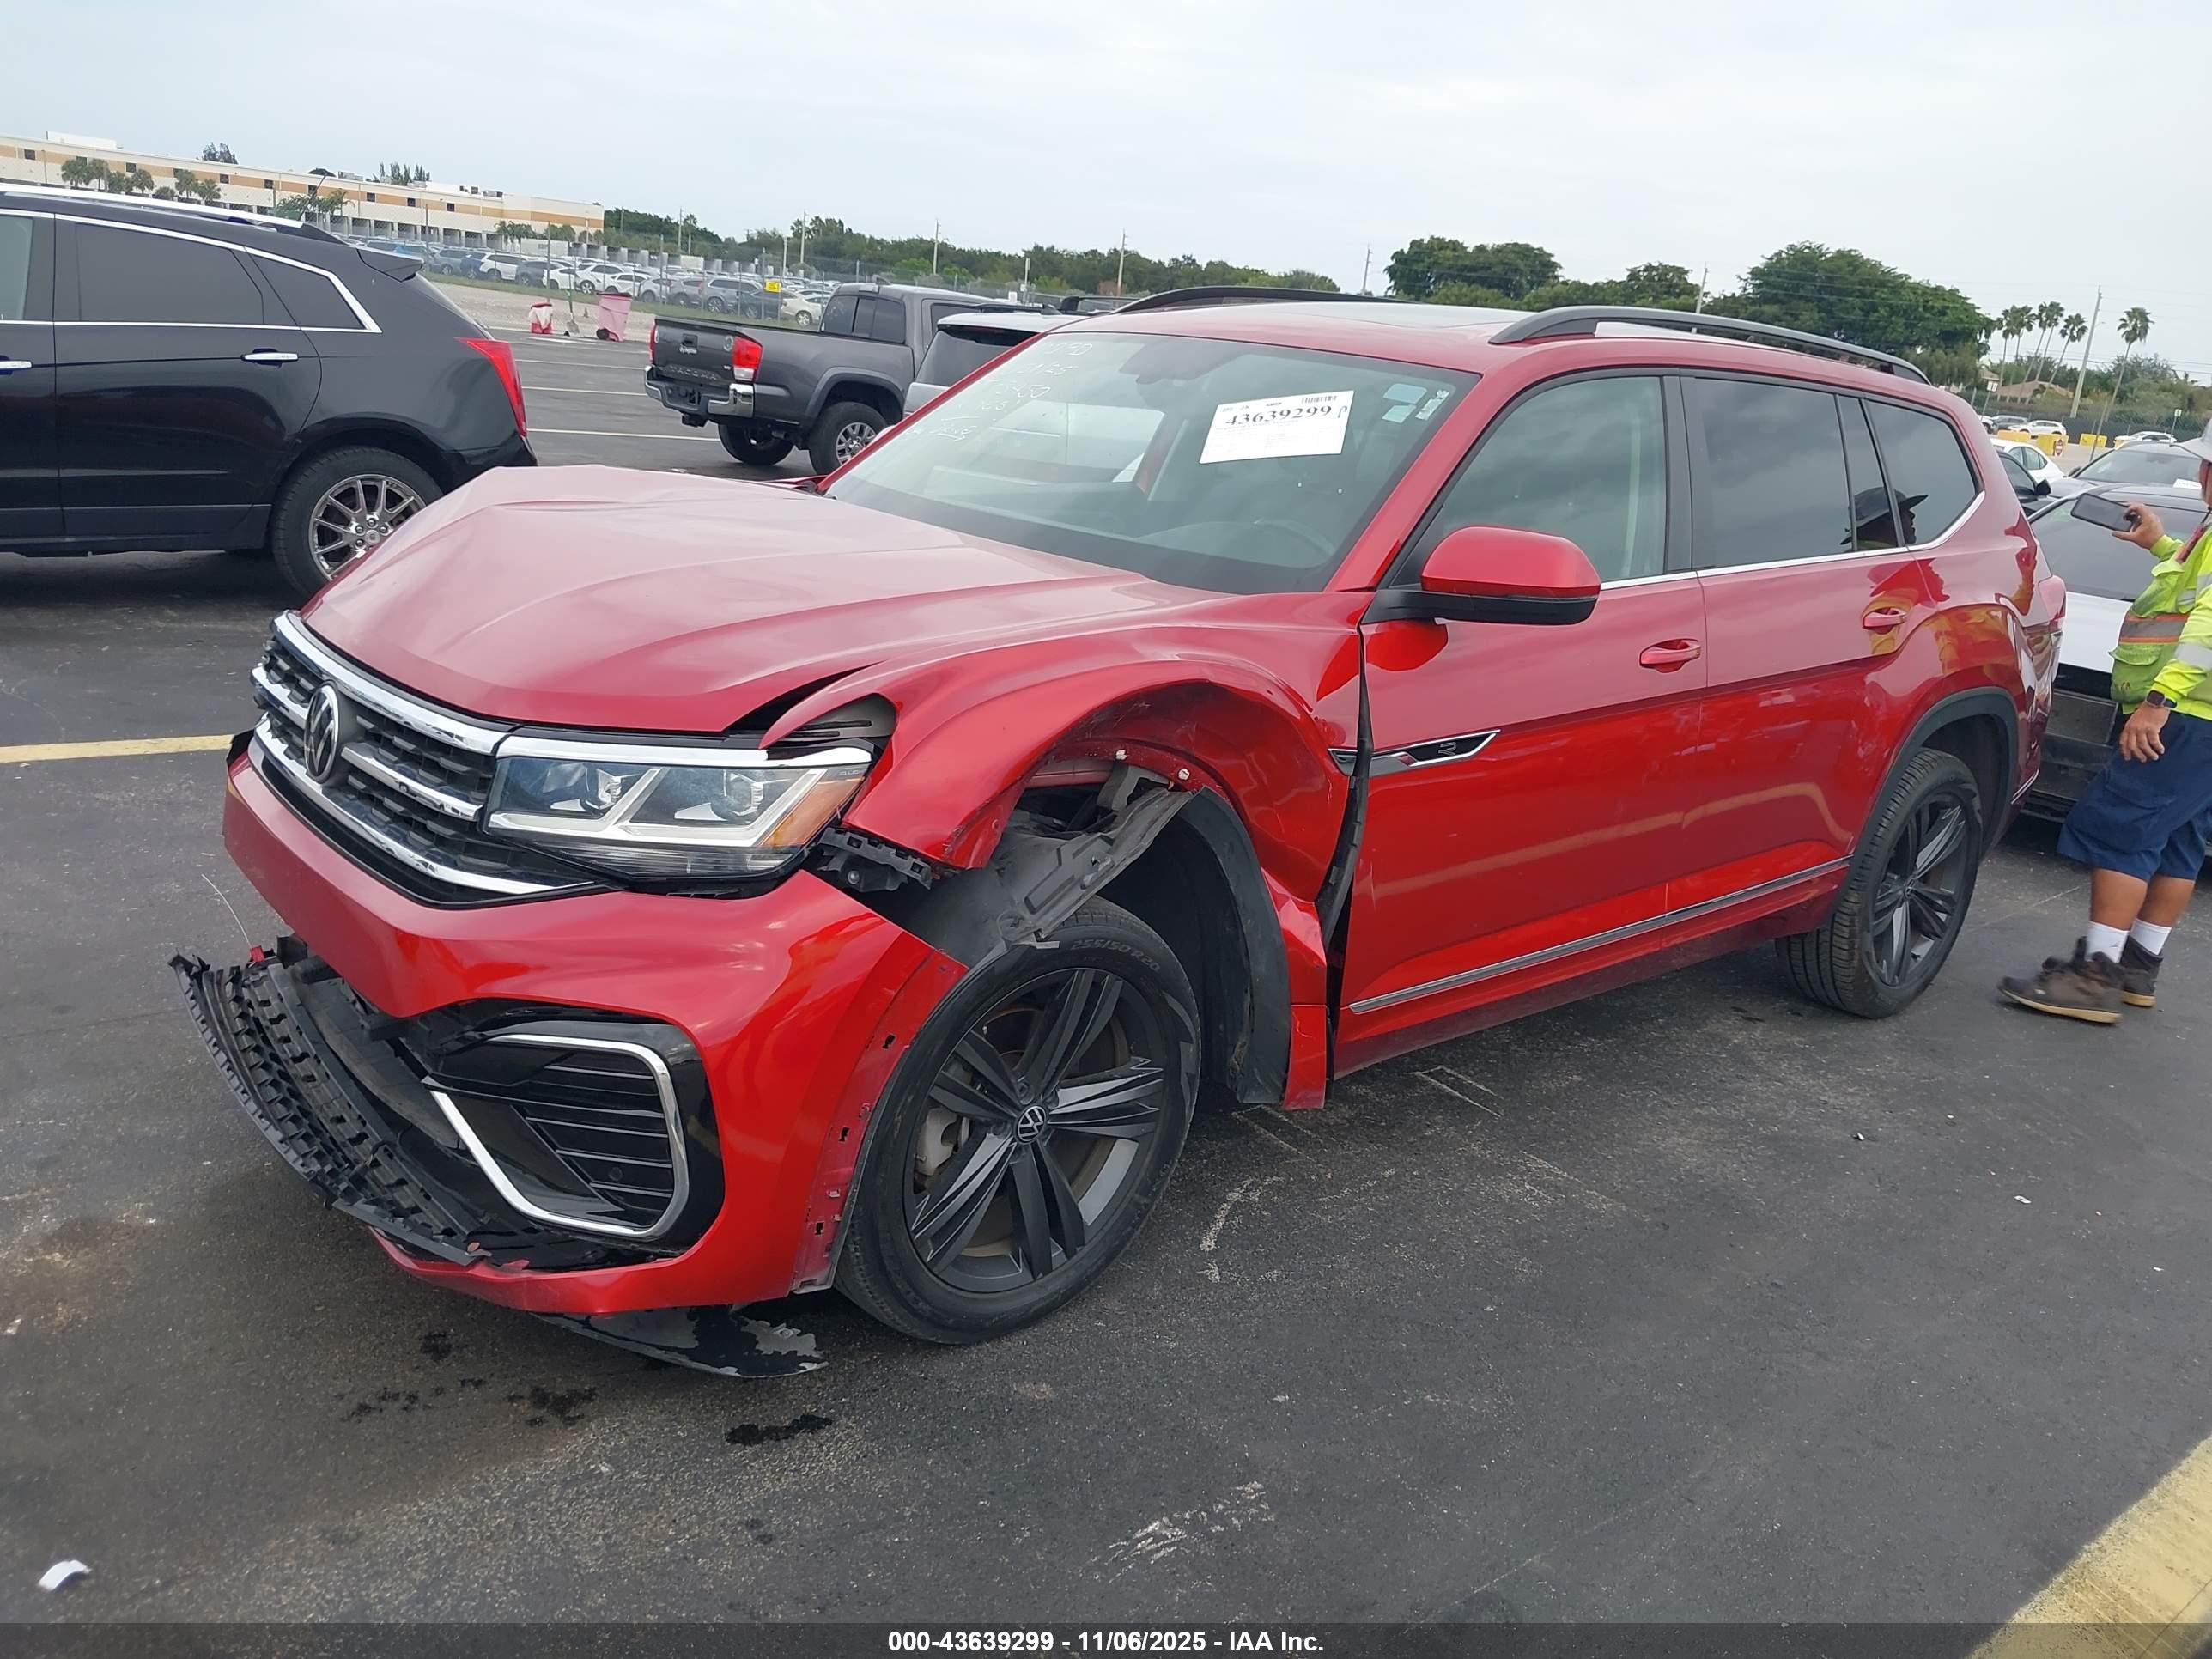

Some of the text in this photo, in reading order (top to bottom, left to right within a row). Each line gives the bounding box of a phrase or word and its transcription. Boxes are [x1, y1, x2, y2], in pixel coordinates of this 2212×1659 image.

[669, 364, 718, 380] TACOMA
[1225, 405, 1332, 425] 43639299
[1437, 741, 1457, 756] R
